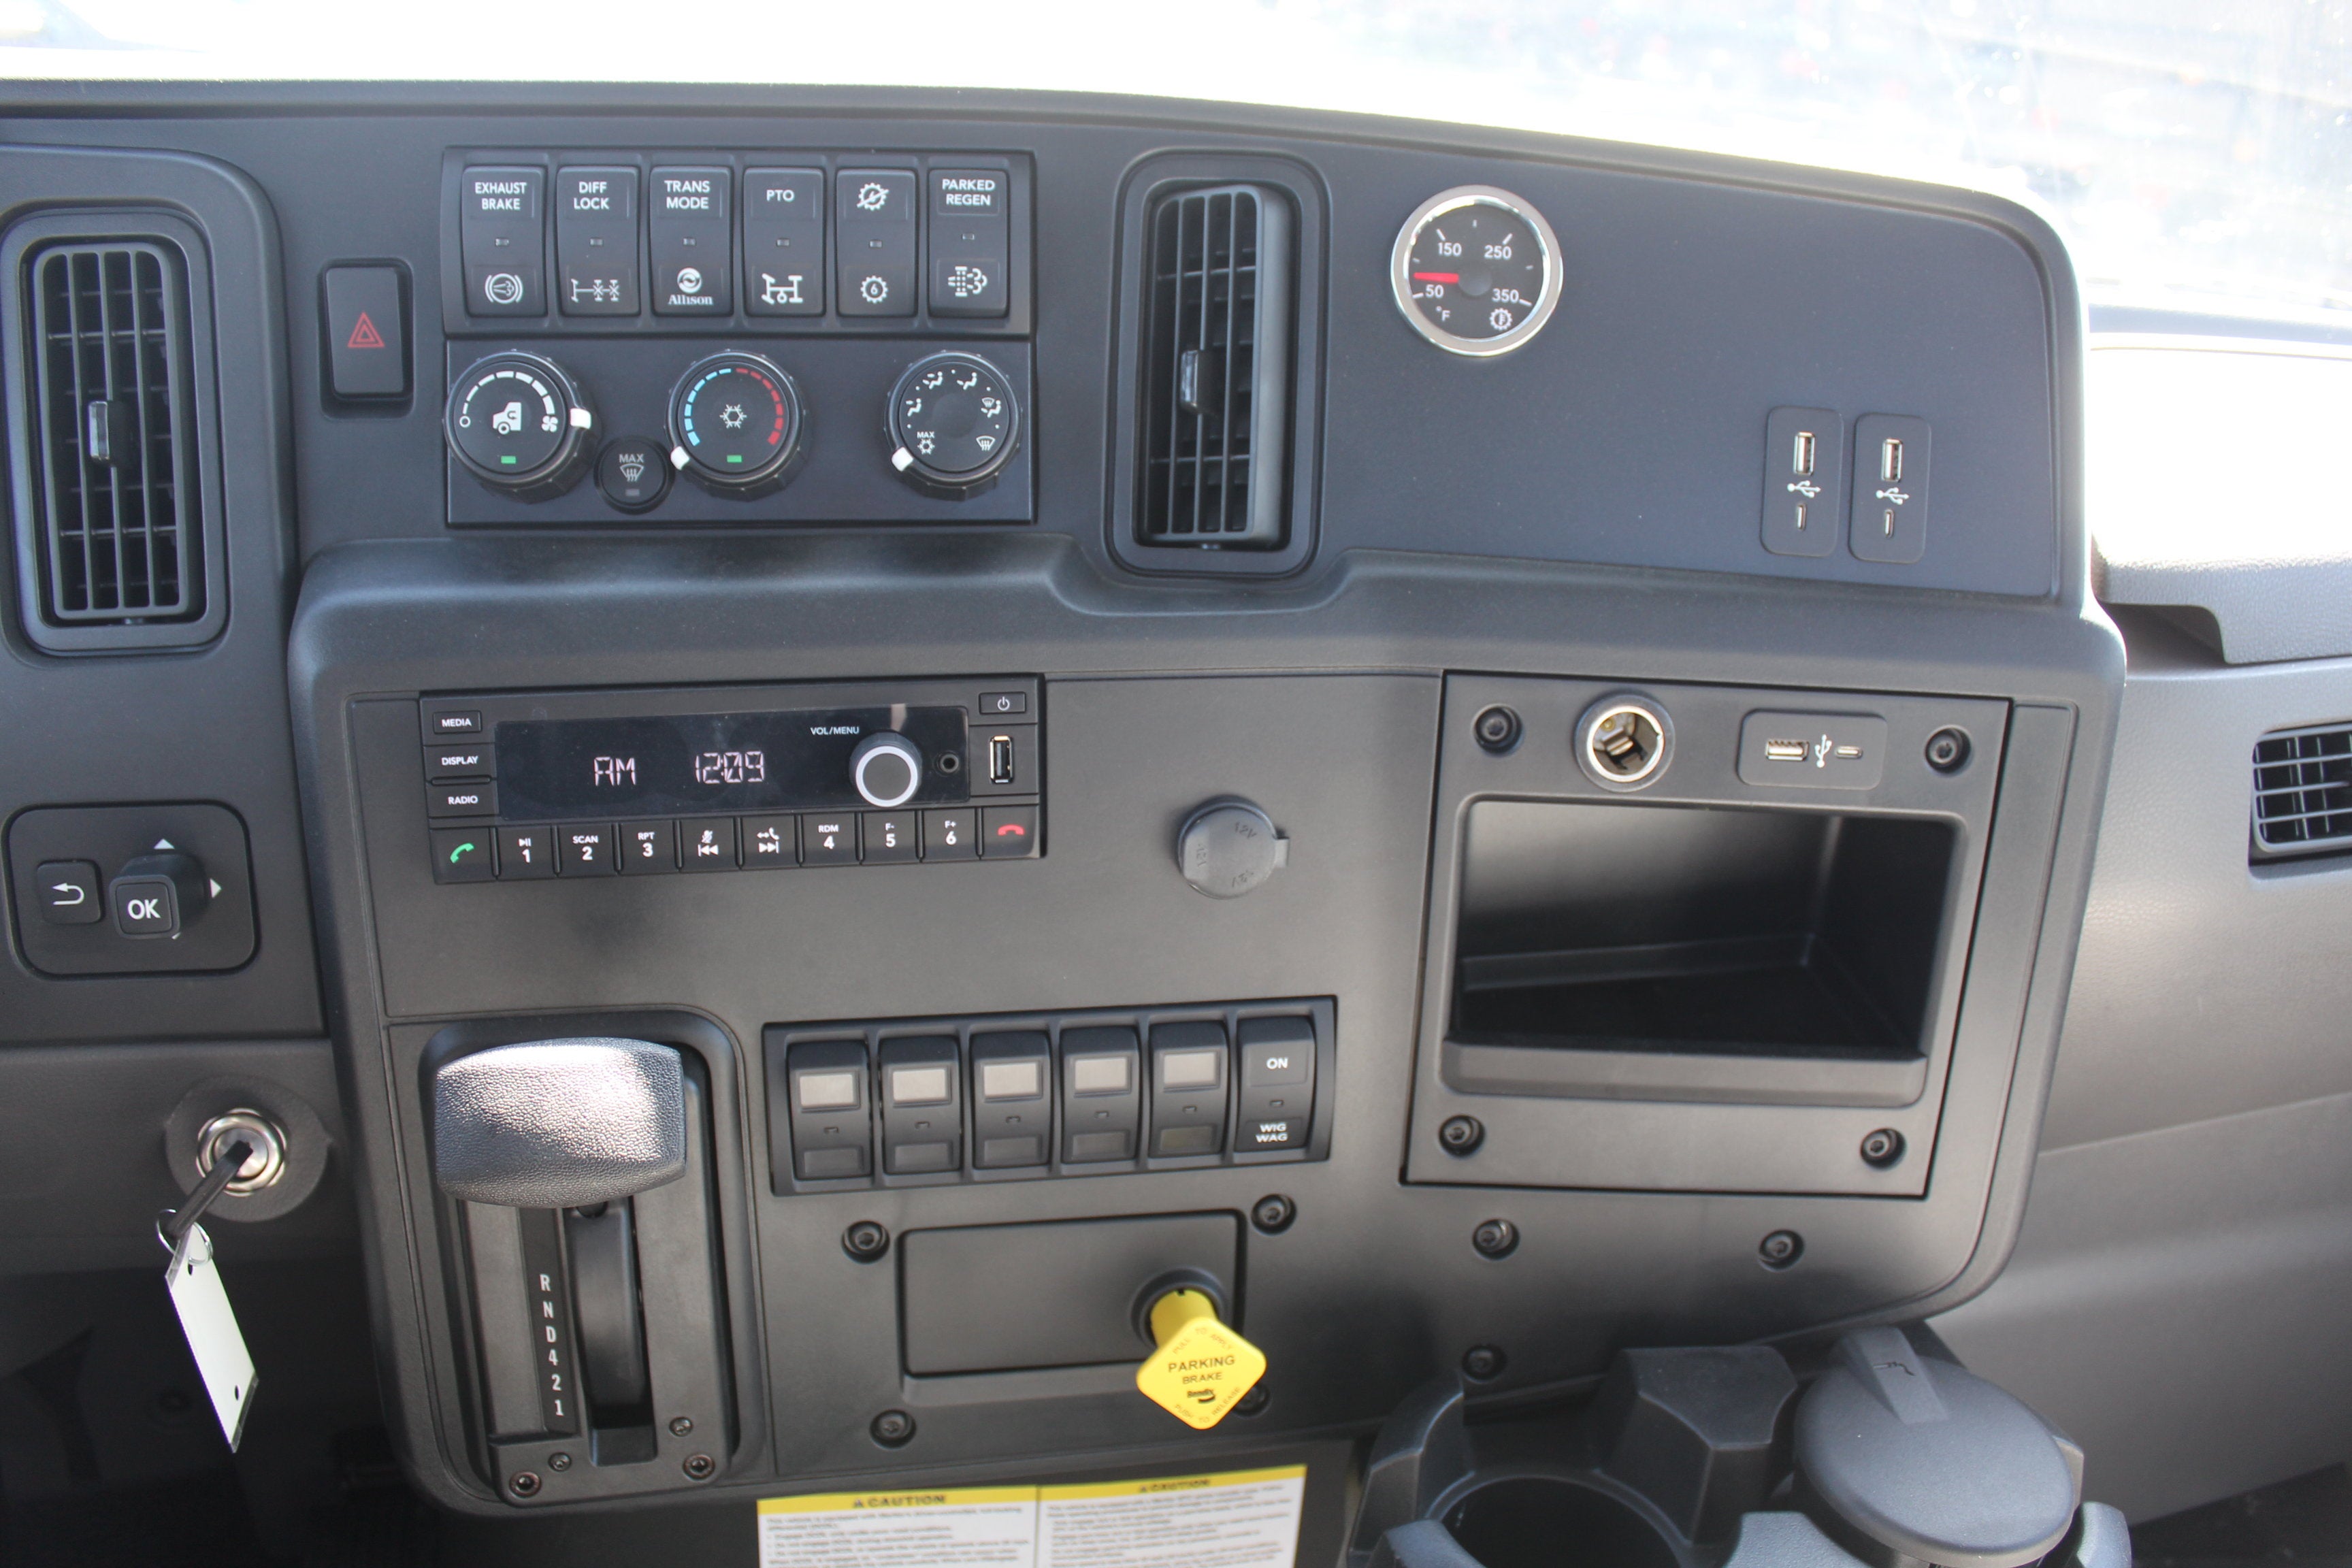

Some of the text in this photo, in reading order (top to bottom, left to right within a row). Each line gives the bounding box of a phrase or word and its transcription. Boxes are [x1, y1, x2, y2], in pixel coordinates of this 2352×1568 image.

[474, 181, 527, 195] EXHAUST
[578, 181, 608, 195] DIFF
[664, 180, 711, 193] TRANS
[942, 178, 996, 192] PARKED
[766, 189, 796, 202] PTO
[946, 193, 992, 206] REGEN
[481, 197, 521, 210] BRAKE
[574, 197, 610, 210] LOCK
[666, 196, 709, 210] MODE
[1437, 242, 1463, 257] 150
[1484, 245, 1512, 260] 250
[1425, 284, 1444, 299] 50
[1492, 288, 1519, 304] 350
[668, 293, 714, 306] Allison
[619, 453, 644, 463] MAX
[442, 718, 472, 728] MEDIA
[810, 725, 860, 736] VOL/MENU
[442, 755, 478, 766] DISPLAY
[593, 756, 637, 787] AM
[448, 795, 478, 806] RADIO
[818, 824, 839, 834] RDM
[572, 834, 599, 845] SCAN
[638, 832, 655, 842] RPT
[823, 836, 835, 850] 4
[885, 834, 896, 848] 5
[945, 830, 957, 845] 6
[522, 849, 531, 864] 1
[581, 846, 593, 862] 2
[642, 843, 654, 858] 3
[127, 898, 161, 920] OK
[1266, 1057, 1289, 1070] ON
[1260, 1122, 1287, 1132] WIG
[1256, 1132, 1288, 1143] WAG
[540, 1273, 551, 1292] R
[542, 1301, 555, 1319] N
[545, 1326, 557, 1343] D
[548, 1349, 559, 1367] 4
[1168, 1355, 1236, 1373] PARKING
[551, 1373, 562, 1392] 2
[1182, 1372, 1223, 1384] BRAKE
[554, 1399, 564, 1416] 1
[868, 1494, 946, 1508] CAUTION
